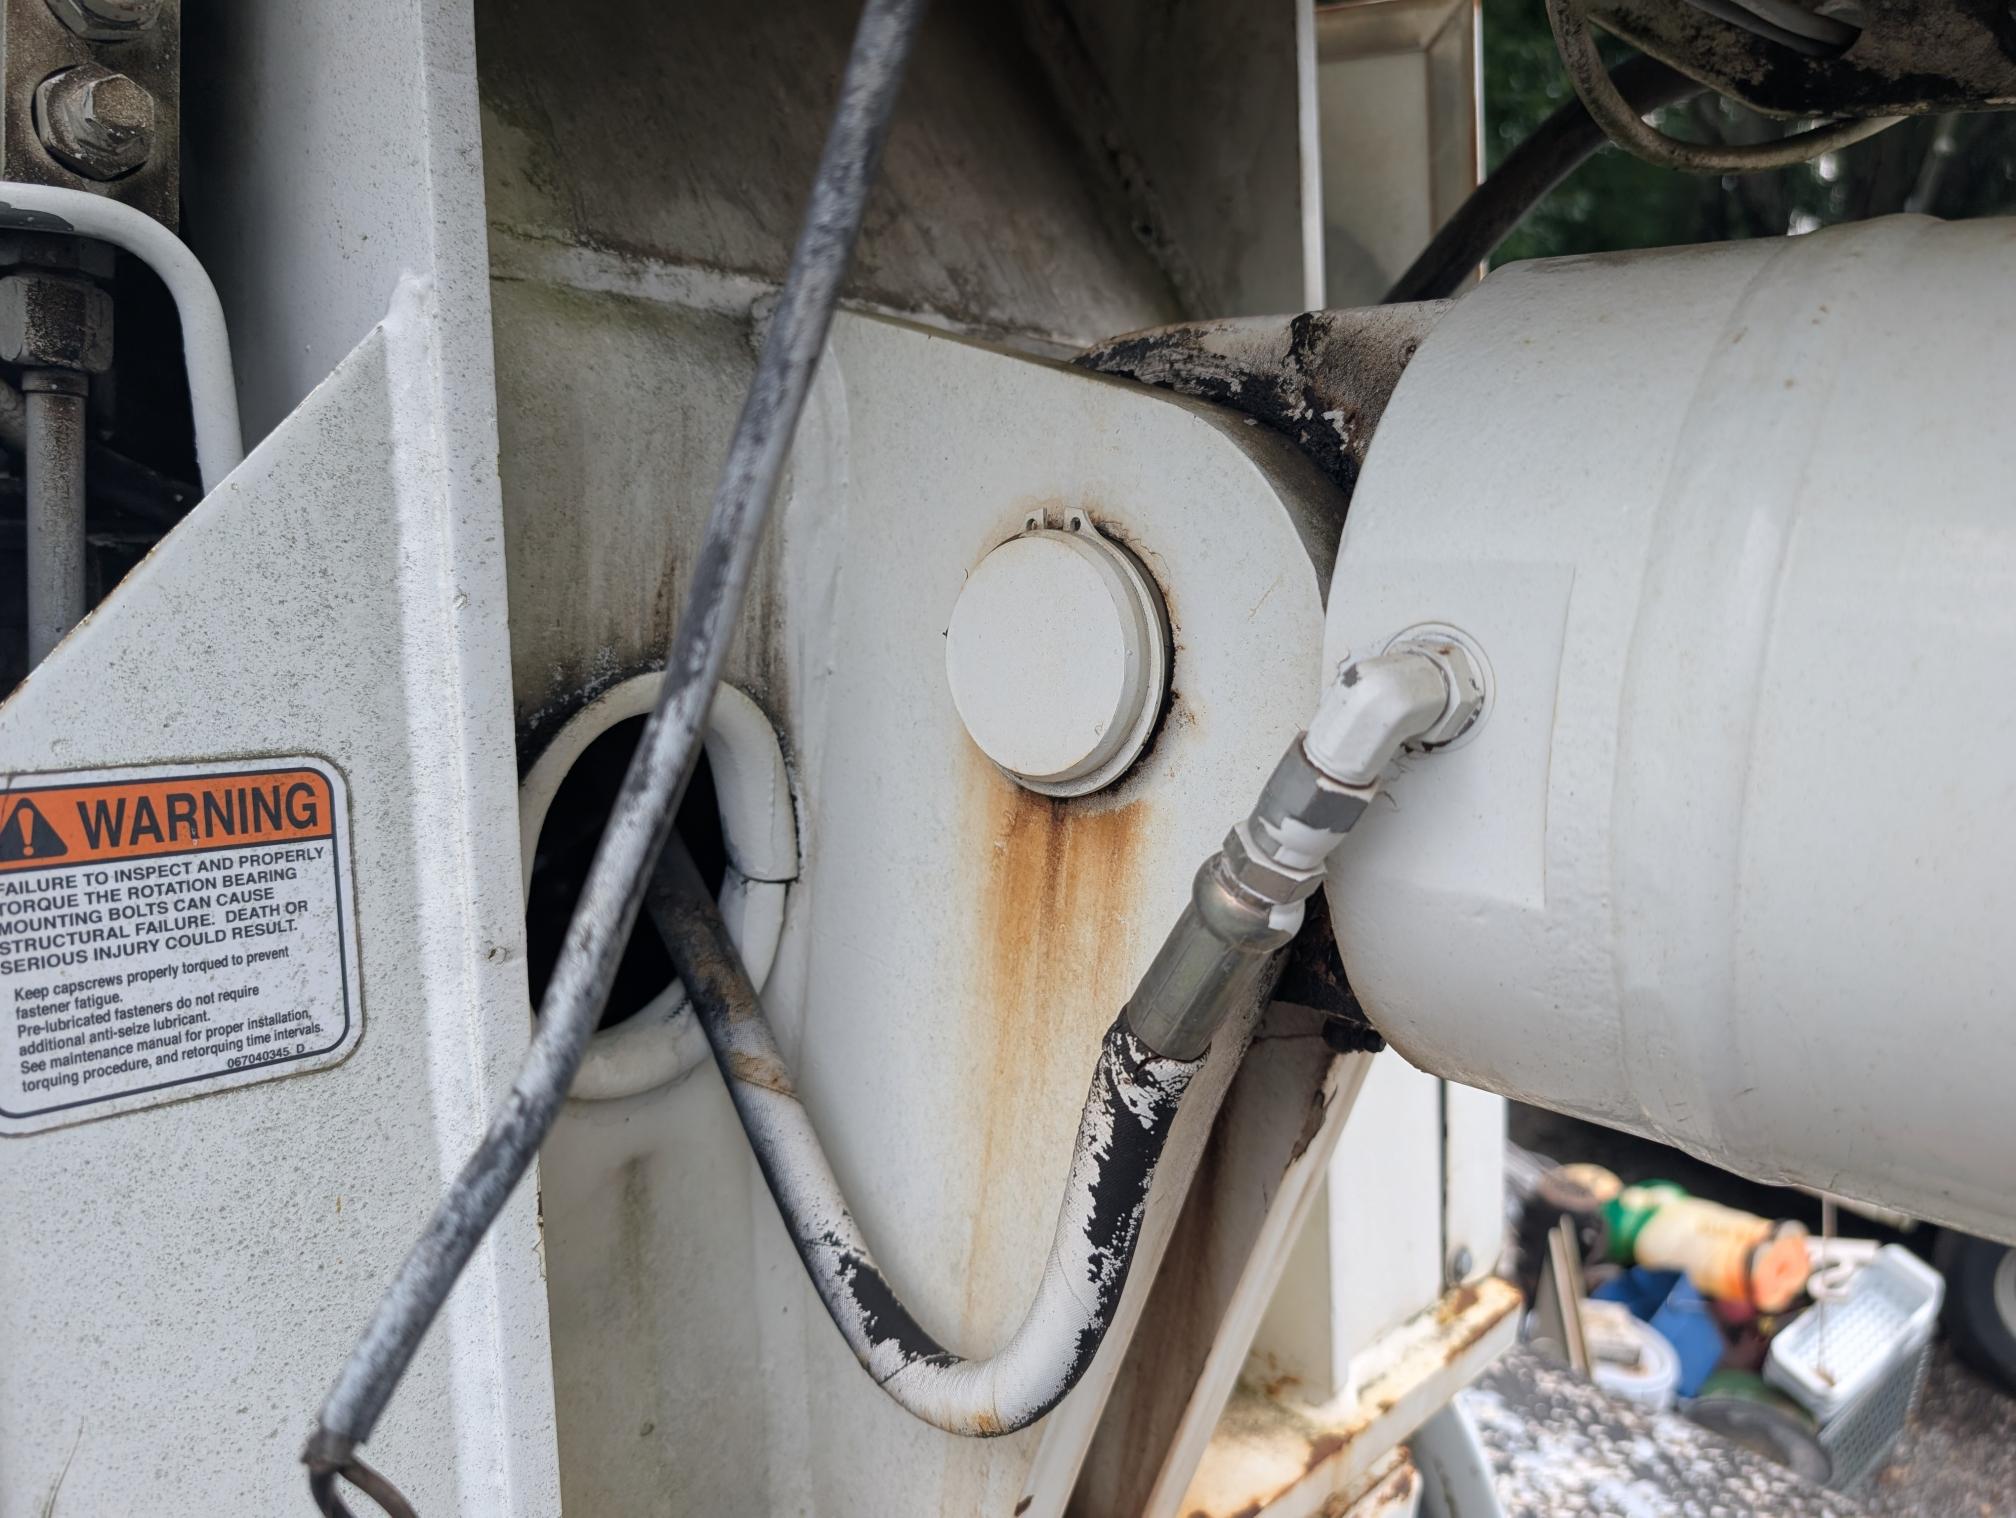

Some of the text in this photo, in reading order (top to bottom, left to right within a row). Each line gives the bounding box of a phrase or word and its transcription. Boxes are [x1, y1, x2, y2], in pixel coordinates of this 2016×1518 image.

[76, 782, 318, 850] WARNING
[0, 867, 297, 916] TORQUE THE ROTATION BEARING
[83, 871, 108, 886] TO
[114, 862, 192, 883] INSPECT
[197, 857, 233, 873] AND
[239, 847, 324, 868] PROPERLY
[0, 887, 274, 936] MOUNTING BOLTS CAN CAUSE
[0, 900, 308, 955] STRUCTURAL FAILURE. DEATH OR
[1, 919, 298, 975] SERIOUS INJURY COULD RESULT.
[15, 946, 289, 1001] Keep capscrews properly torqued to prevent
[16, 993, 123, 1020] fastener fatigue.
[18, 985, 259, 1038] Pre-lubricated fasteners do not require
[19, 1010, 210, 1056] additional anti-seize lubricant.
[21, 1009, 312, 1074] See maintenance manual for proper installation,
[23, 1022, 324, 1092] torquing procedure, and retorquing time intervals.
[228, 1044, 305, 1068] 067040345 D
